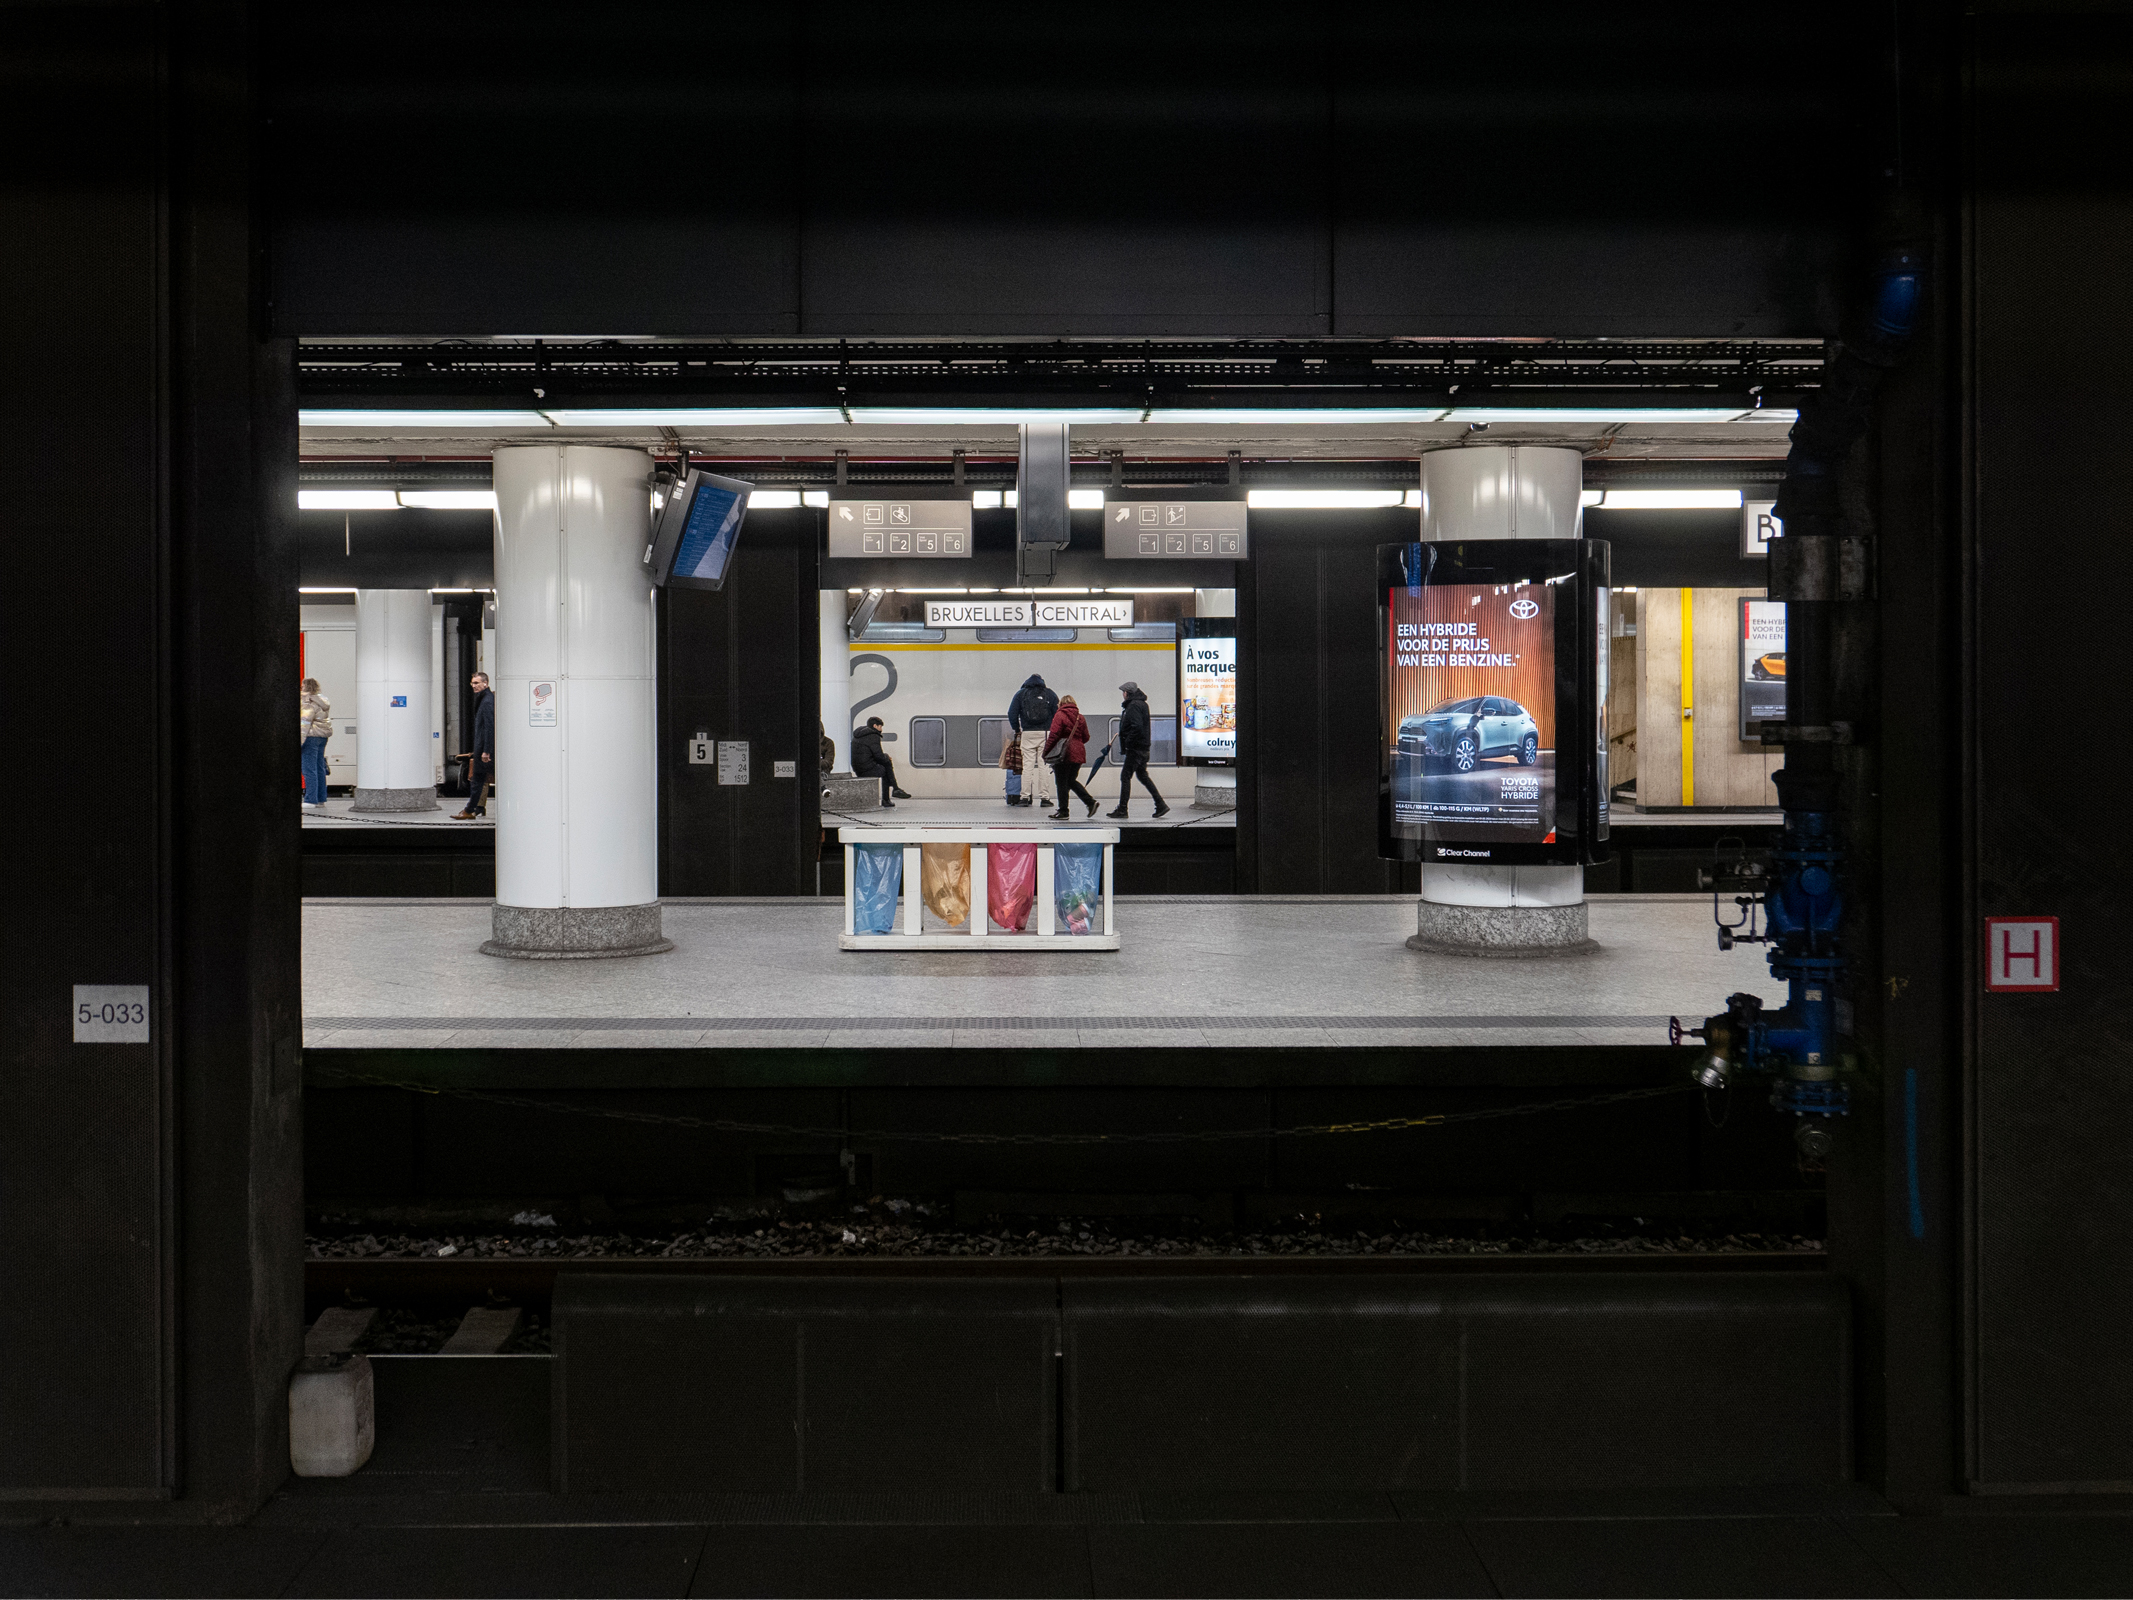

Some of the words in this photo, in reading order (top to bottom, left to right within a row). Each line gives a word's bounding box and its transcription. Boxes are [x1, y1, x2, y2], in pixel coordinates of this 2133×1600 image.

[875, 540, 881, 550] 1
[900, 540, 907, 550] 2
[927, 540, 934, 550] 5
[953, 540, 961, 550] 6
[1151, 541, 1156, 551] 1
[1176, 541, 1183, 551] 2
[1202, 541, 1209, 551] 5
[1229, 541, 1236, 551] 6
[931, 606, 1024, 622] BRUXELLES
[1398, 624, 1418, 637] EEN
[1420, 622, 1477, 636] HYBRIDE
[1397, 639, 1430, 651] VOOR
[1432, 638, 1450, 651] DE
[1452, 638, 1490, 651] PRIJS
[1186, 644, 1194, 660] À
[1197, 650, 1220, 660] vos
[1397, 654, 1419, 667] VAN
[1421, 654, 1446, 667] EEN
[696, 743, 706, 760] 5
[741, 753, 747, 762] 3
[738, 763, 747, 772] 24
[775, 765, 794, 773] 3-033
[734, 774, 748, 783] 1512
[1501, 777, 1539, 786] TOYOTA
[1501, 791, 1539, 800] HYBRIDE
[1446, 849, 1462, 857] Clear
[2003, 929, 2040, 978] H
[78, 1003, 145, 1024] 5-033
